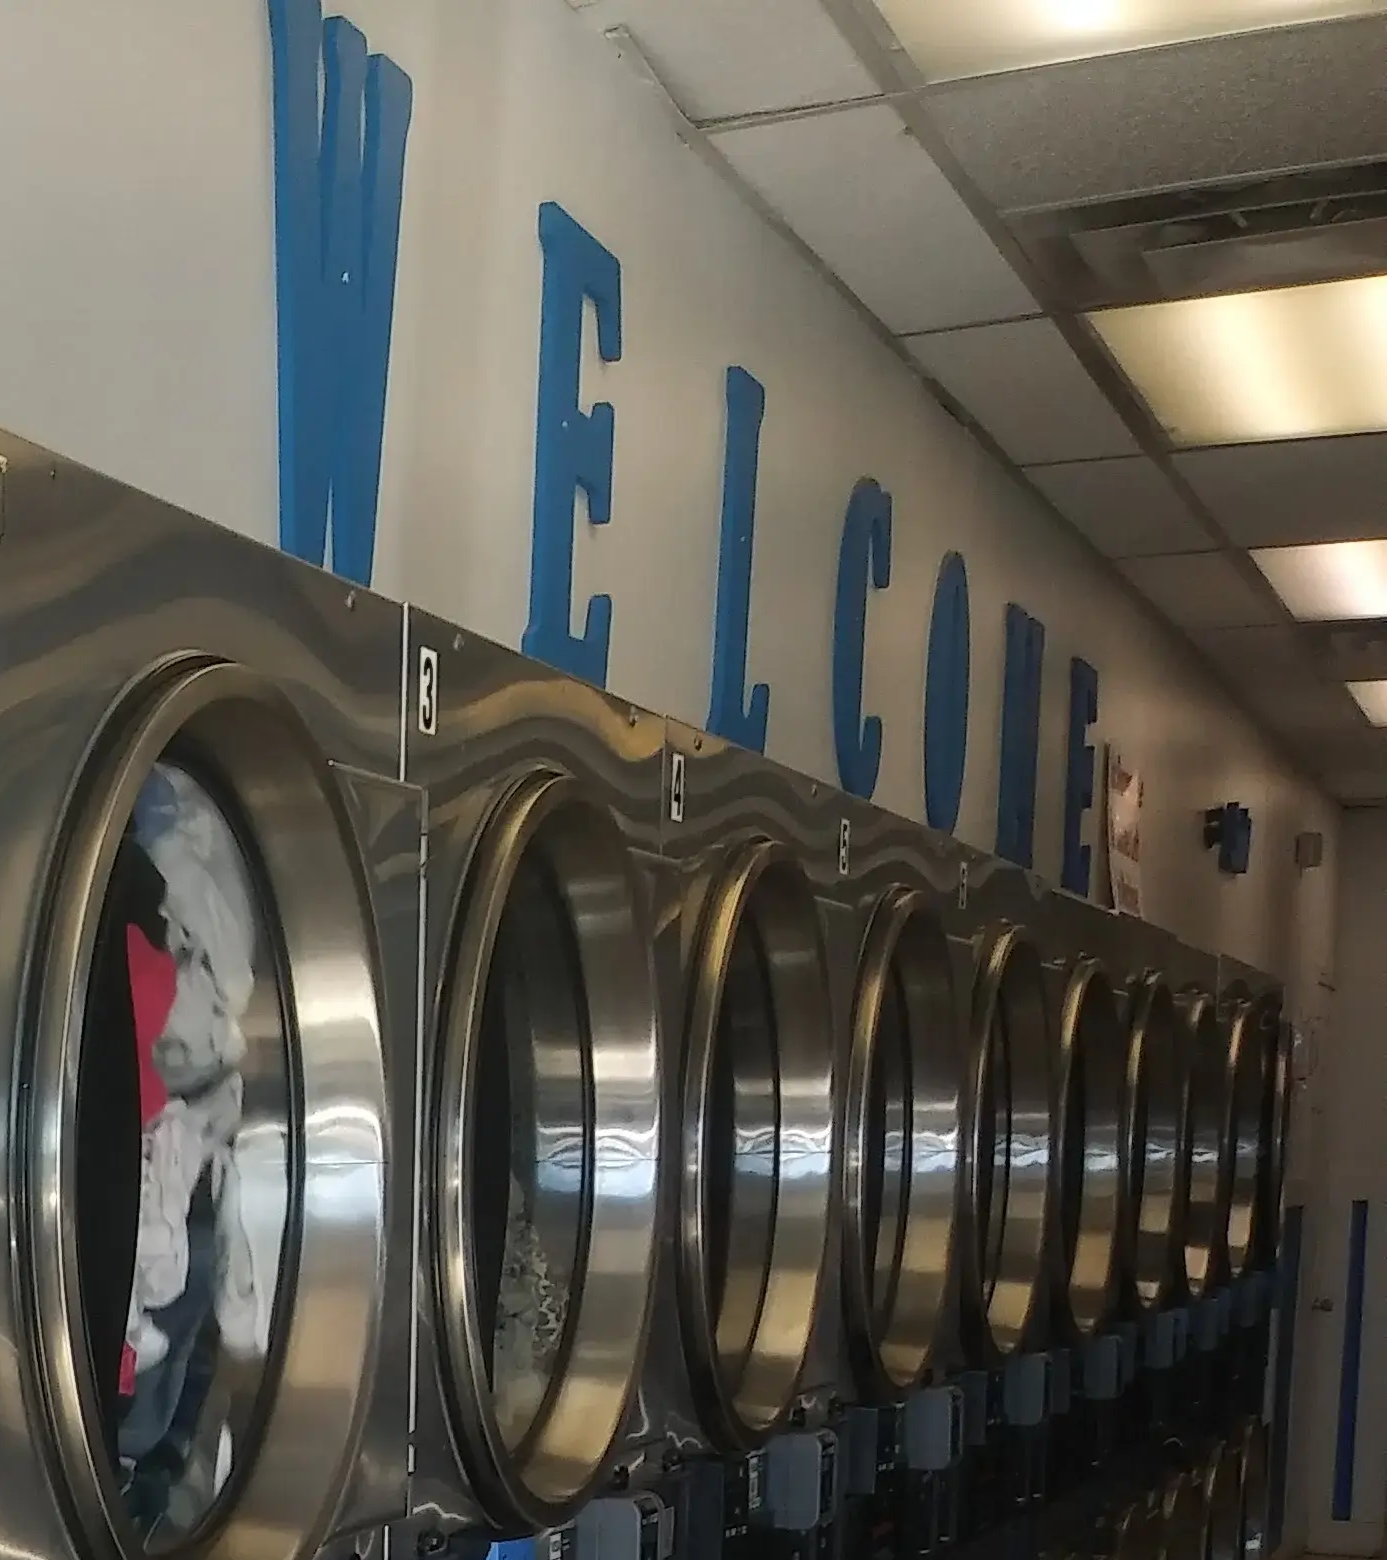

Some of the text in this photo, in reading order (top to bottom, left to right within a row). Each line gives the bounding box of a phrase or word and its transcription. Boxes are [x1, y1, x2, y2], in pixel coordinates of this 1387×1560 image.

[268, 0, 1100, 898] WELCOME
[421, 657, 434, 724] 3
[672, 763, 683, 815] 4
